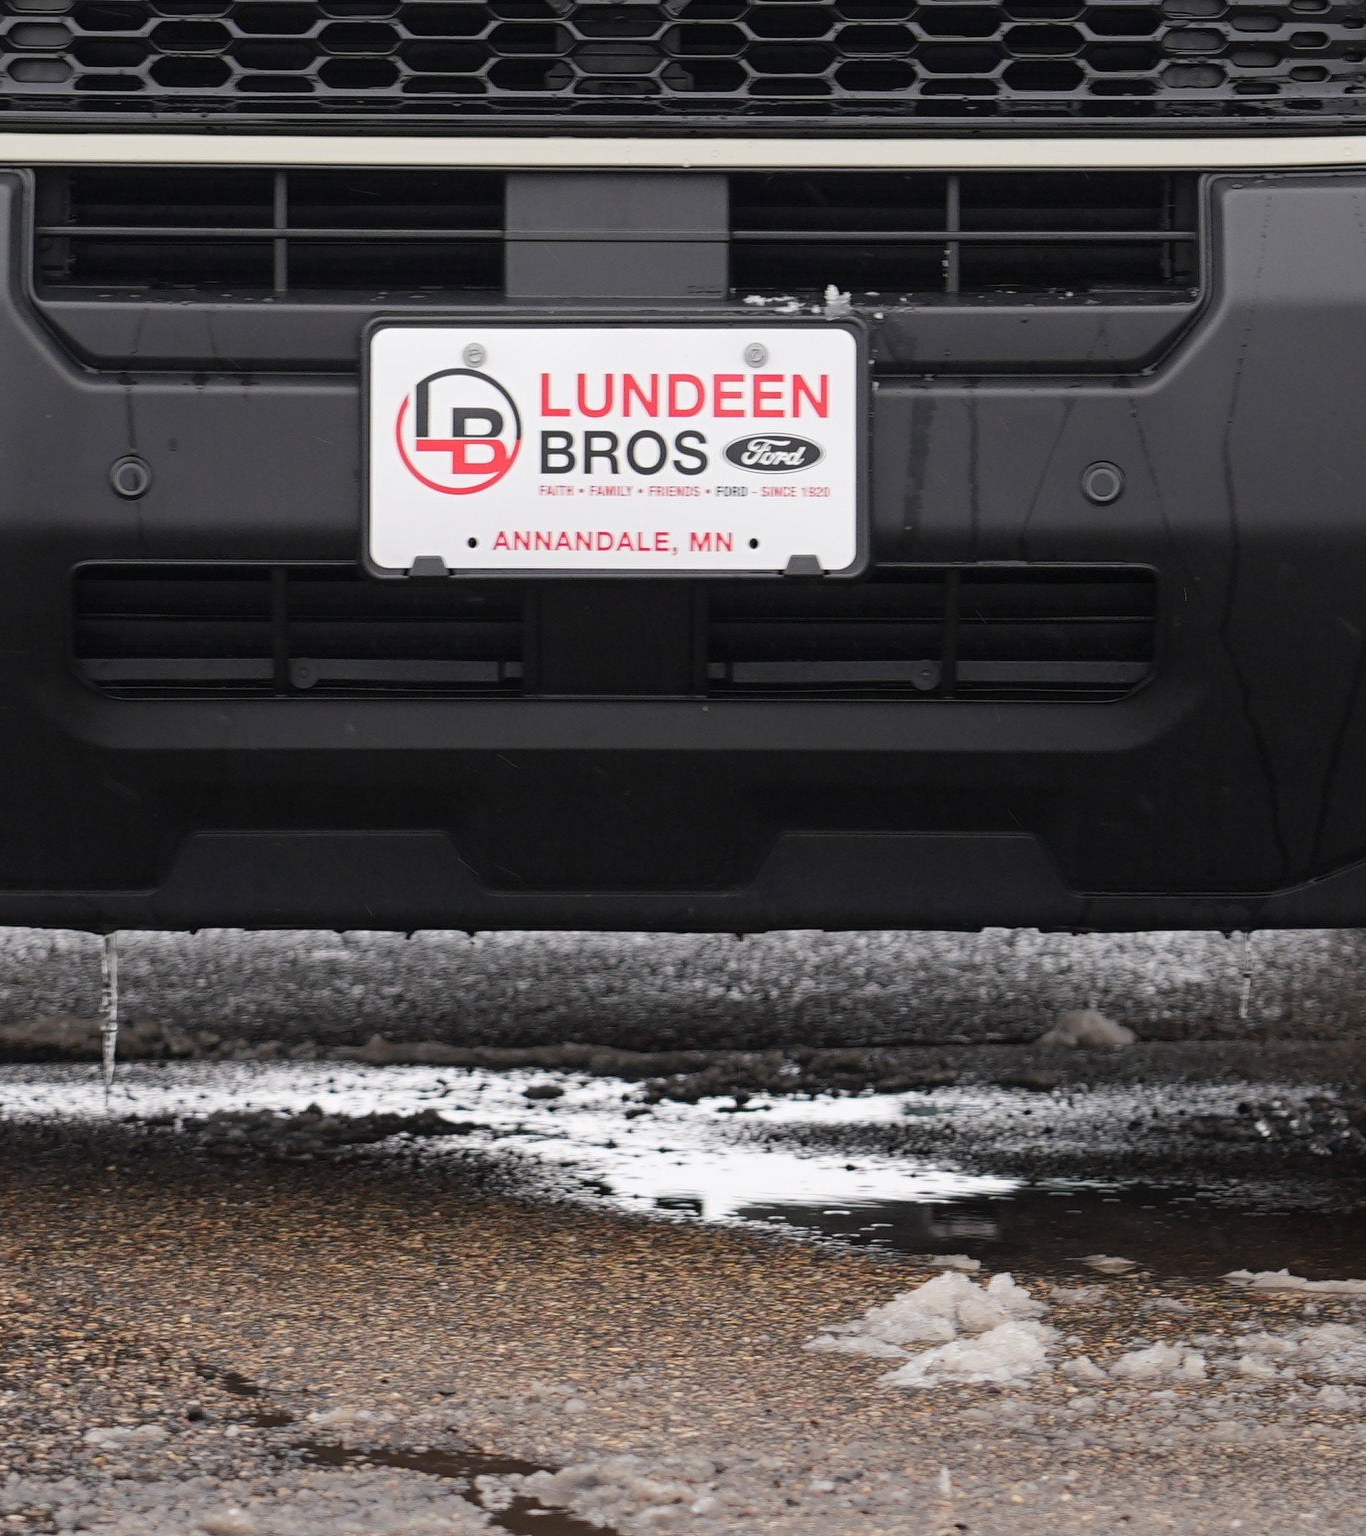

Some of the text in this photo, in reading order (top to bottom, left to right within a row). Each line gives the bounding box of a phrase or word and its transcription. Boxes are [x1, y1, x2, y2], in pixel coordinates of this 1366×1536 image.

[539, 372, 831, 419] LUNDEEN
[540, 429, 709, 476] BROS
[538, 484, 575, 498] FAITH
[588, 484, 634, 498] FAMILY
[648, 484, 702, 498] FRIENDS
[715, 485, 749, 498] FORD
[760, 485, 798, 498] SINCE
[492, 530, 735, 557] ANNANDALE, MN
